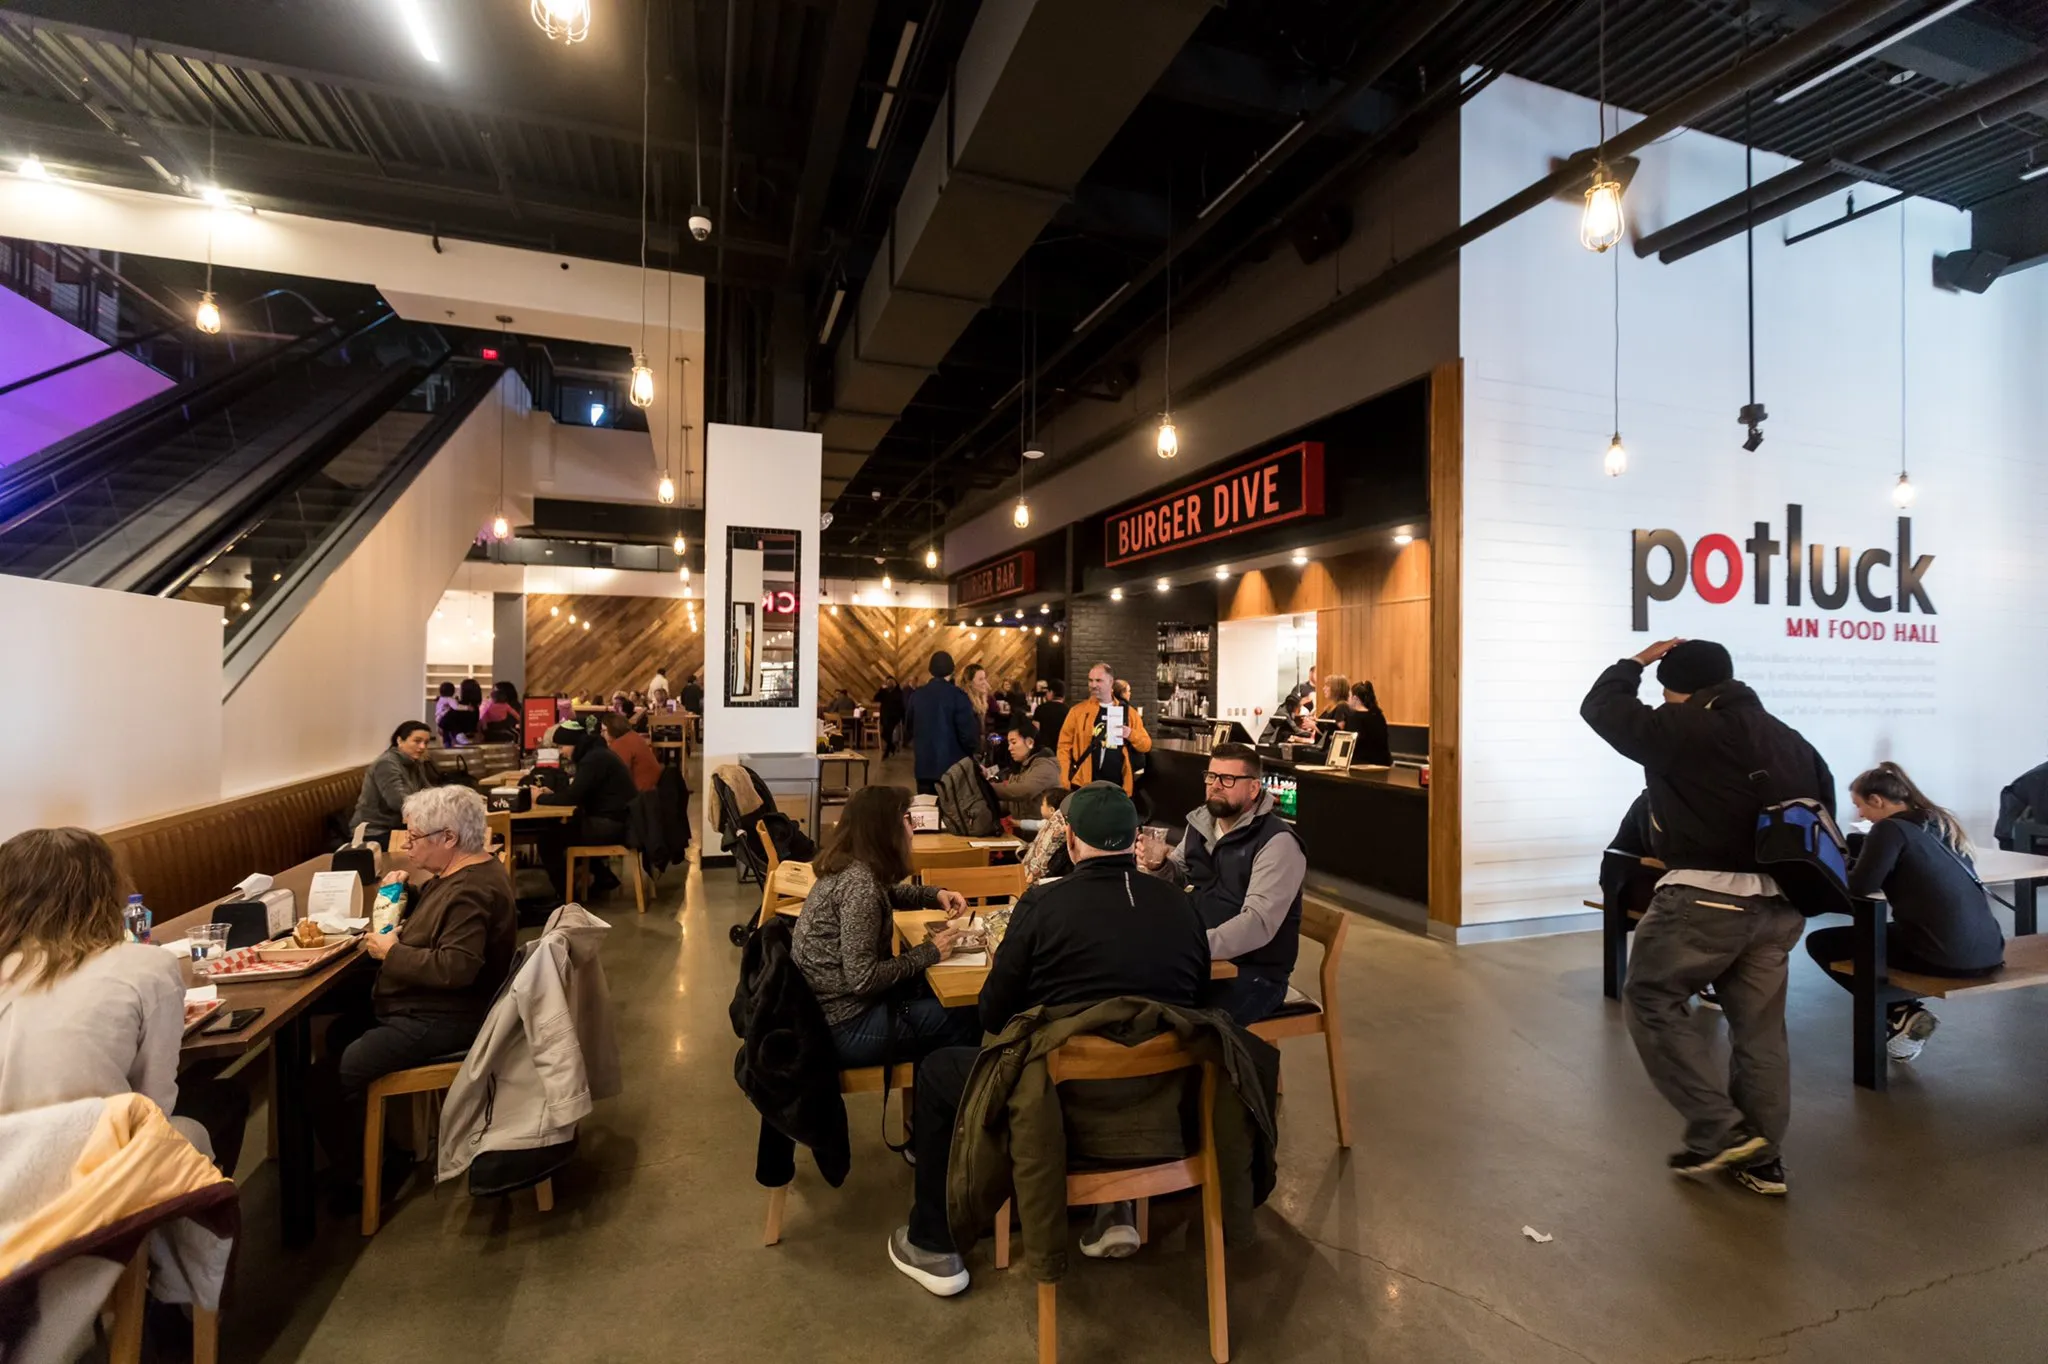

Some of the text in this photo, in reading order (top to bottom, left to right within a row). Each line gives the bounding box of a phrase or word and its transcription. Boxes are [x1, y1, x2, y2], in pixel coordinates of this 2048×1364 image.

[1118, 464, 1280, 556] BURGER DIVE
[1631, 503, 1939, 632] potluck
[1786, 617, 1940, 644] MN FOOD HALL
